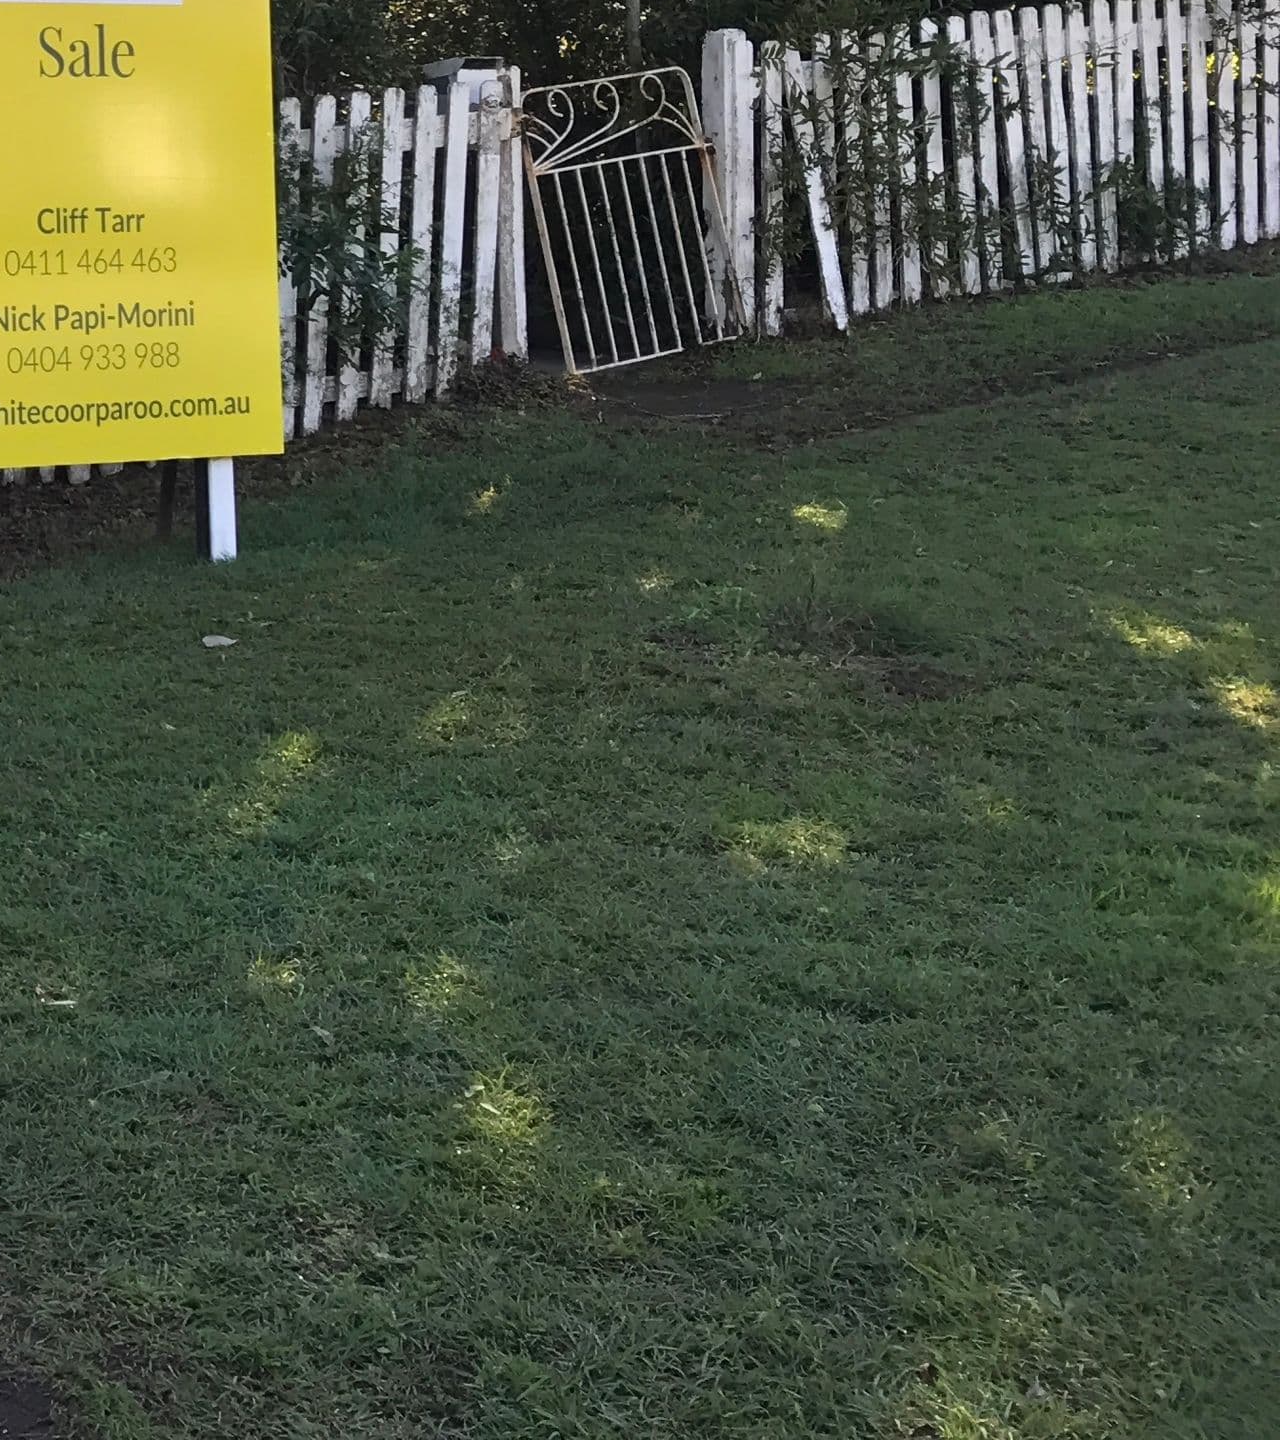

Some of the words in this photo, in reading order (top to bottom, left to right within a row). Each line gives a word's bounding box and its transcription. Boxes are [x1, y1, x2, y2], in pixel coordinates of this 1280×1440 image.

[39, 23, 136, 79] Sale
[36, 207, 89, 235] Cliff
[95, 206, 146, 234] Tarr
[4, 249, 69, 277] 0411
[76, 248, 125, 275] 464
[131, 246, 178, 274] 463
[54, 300, 196, 335] Papi-Morini
[6, 346, 72, 375] 0404
[79, 343, 127, 371] 933
[134, 341, 181, 369] 988
